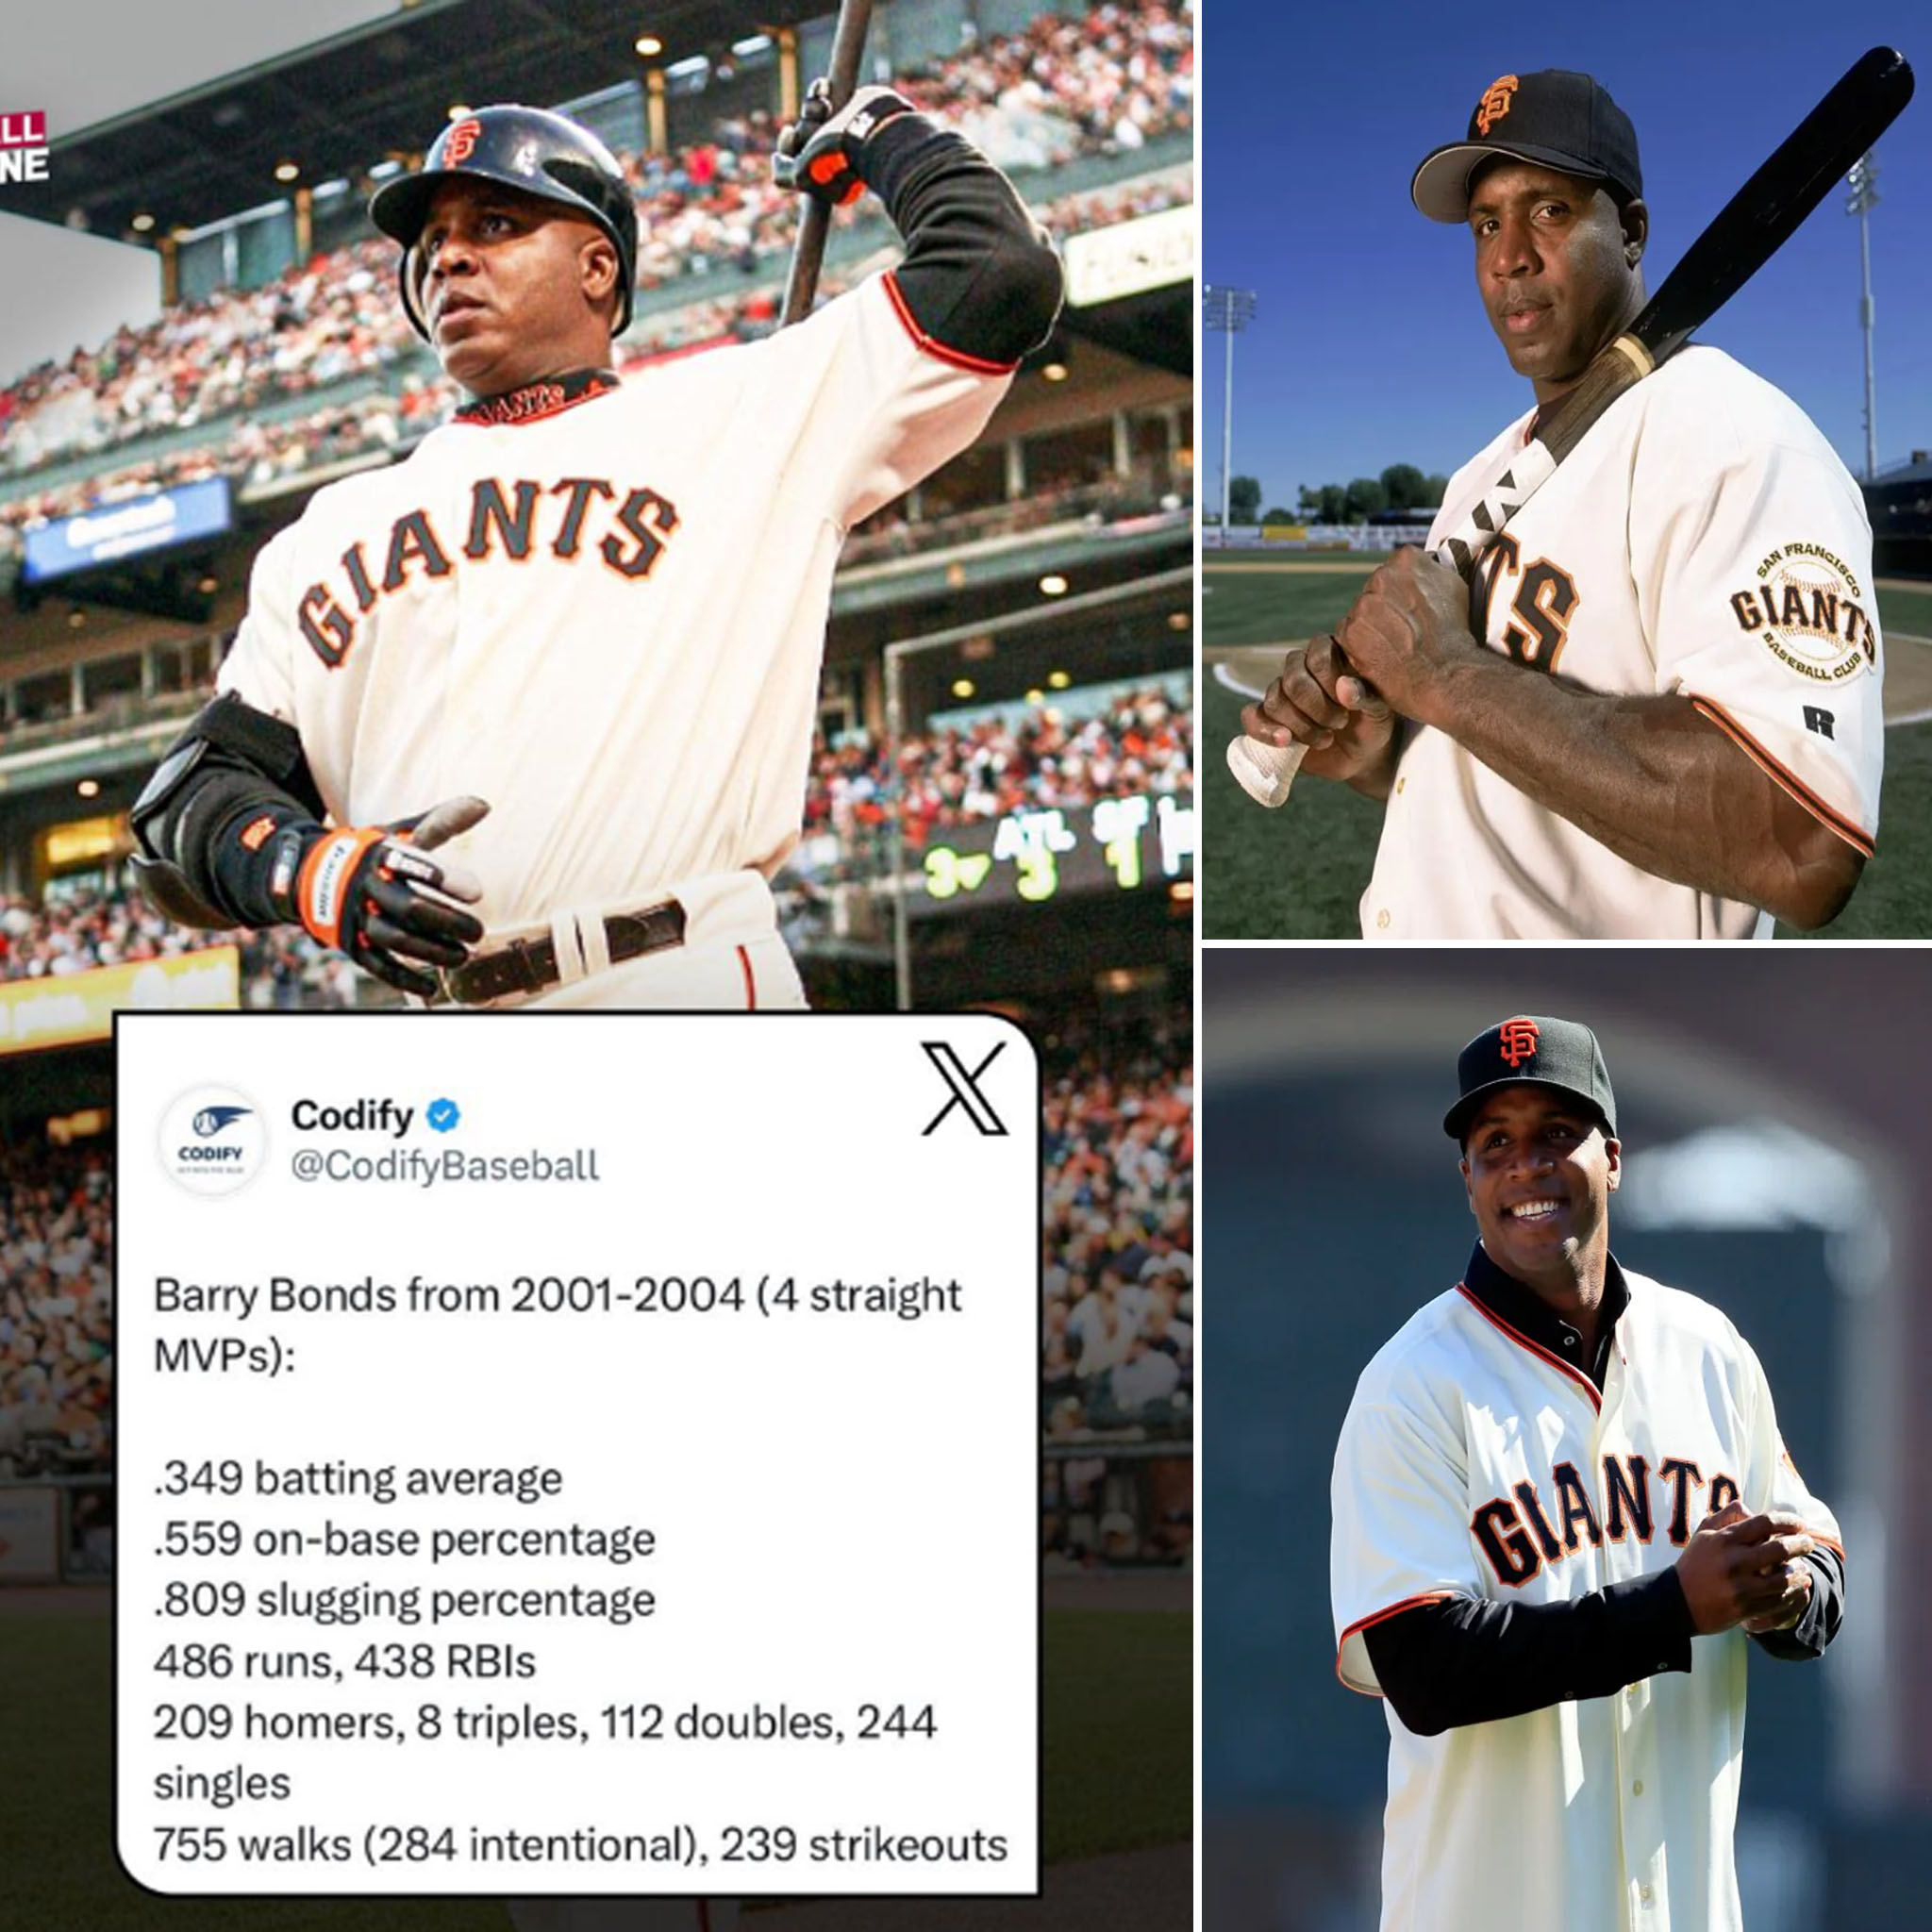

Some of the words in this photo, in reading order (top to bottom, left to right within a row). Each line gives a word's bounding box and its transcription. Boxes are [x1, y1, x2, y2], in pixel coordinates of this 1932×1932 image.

[297, 476, 681, 671] GIANTS
[1757, 550, 1783, 578] SAN
[1784, 542, 1861, 598] FRANCISCO
[1729, 584, 1875, 666] GIANTS
[1762, 631, 1832, 681] BASEBALL
[1833, 651, 1861, 680] CLUB
[1802, 704, 1835, 741] R
[1500, 1018, 1540, 1067] SF
